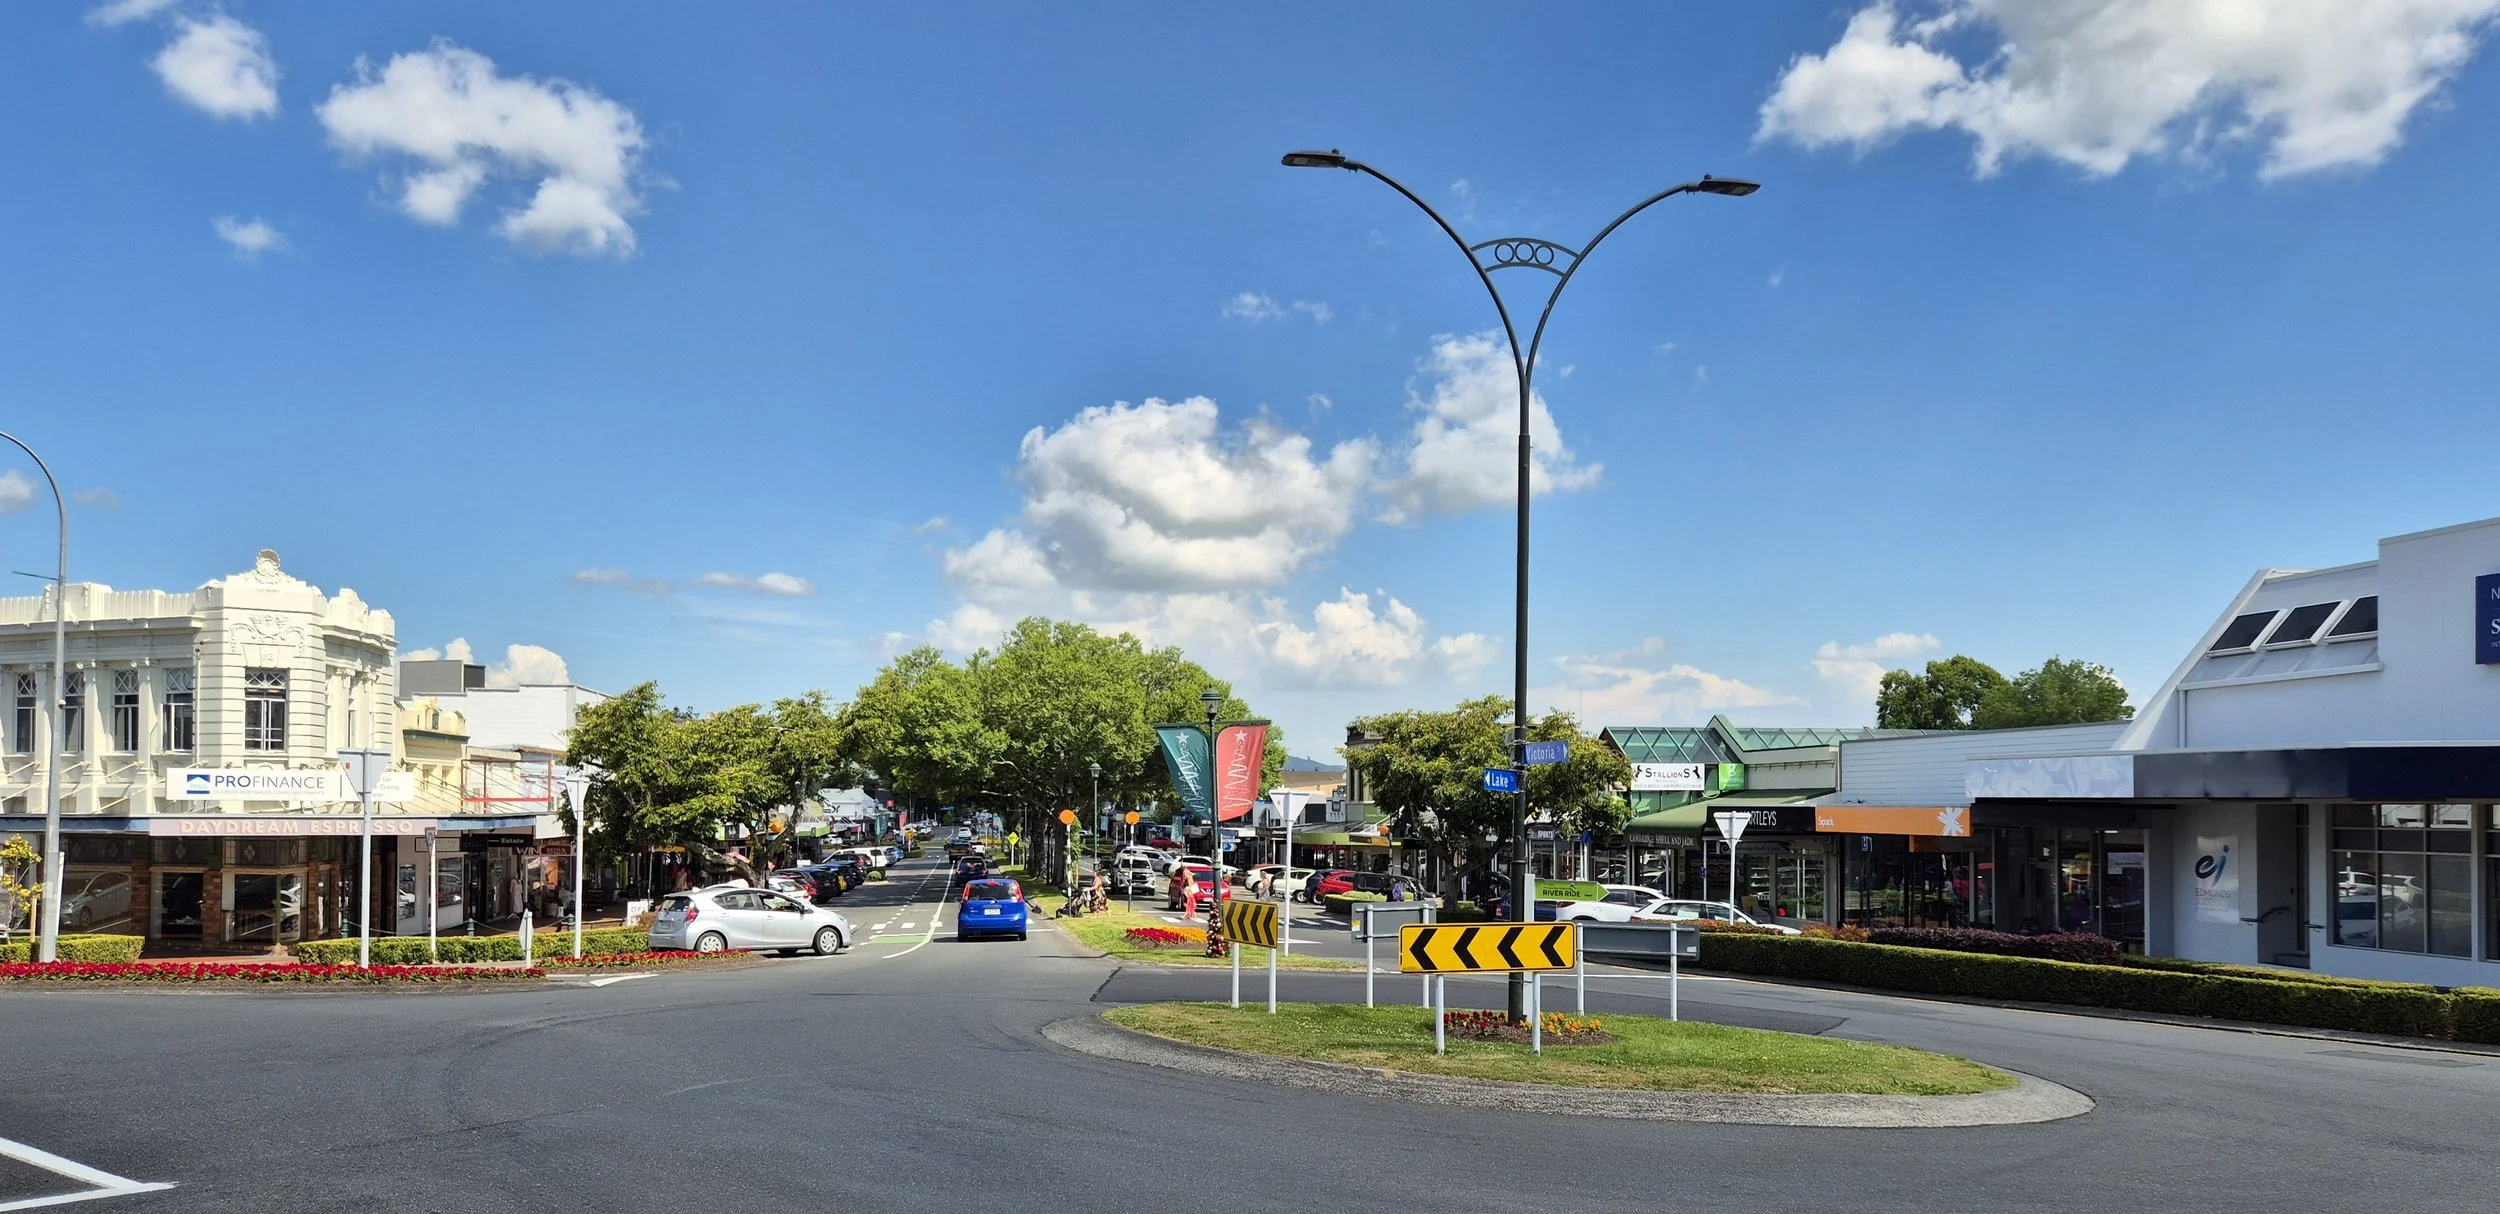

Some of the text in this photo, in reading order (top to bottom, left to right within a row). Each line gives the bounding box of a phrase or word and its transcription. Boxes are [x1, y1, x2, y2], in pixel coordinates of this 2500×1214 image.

[1525, 745, 1555, 762] Victoria
[215, 776, 325, 788] PROFINANCE
[1491, 772, 1509, 788] Lake
[180, 820, 413, 835] DAYDREAM ESPRSSO
[1817, 816, 1835, 828] Spark
[1538, 830, 1554, 839] SPORTS
[1671, 836, 1681, 846] AND
[1681, 836, 1694, 848] JADE
[1543, 889, 1581, 898] RIVER RIDE
[2195, 888, 2231, 898] EDMONDS
